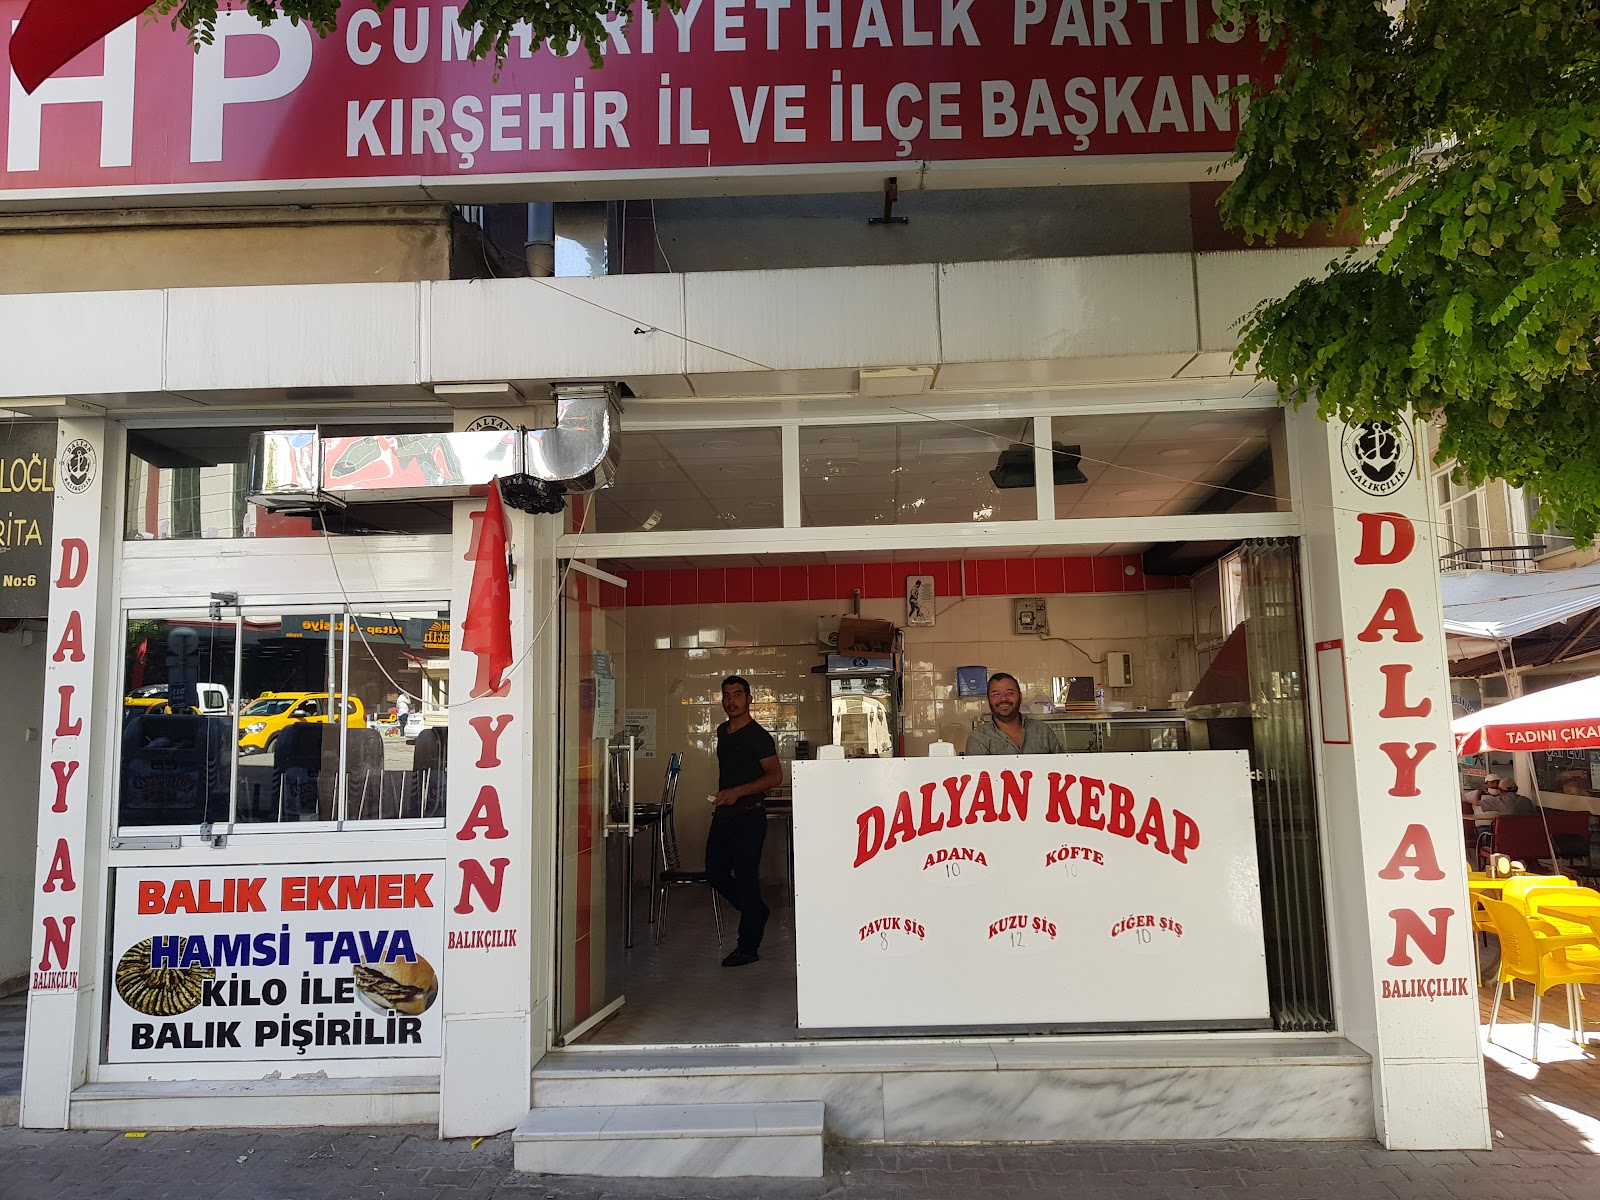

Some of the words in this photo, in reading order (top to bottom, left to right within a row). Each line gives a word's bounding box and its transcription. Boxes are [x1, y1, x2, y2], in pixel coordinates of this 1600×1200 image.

[346, 77, 631, 169] KIRŞEHİR
[659, 73, 709, 145] İL
[729, 85, 806, 143] VE
[830, 69, 963, 157] İLÇE
[0, 452, 57, 492] LOĞL
[1350, 467, 1406, 493] BALIKÇILIK
[3, 575, 37, 587] No:6
[1354, 511, 1455, 967] DALYAN
[1506, 729, 1557, 744] TADINI
[38, 538, 89, 971] DALYAN
[853, 770, 1033, 868] DALYAN
[1045, 772, 1200, 864] KEBAP
[922, 847, 988, 870] ADANA
[1045, 844, 1105, 867] KÖFTE
[945, 863, 961, 877] 10
[138, 877, 267, 915] BALIK
[280, 873, 434, 912] EKMEK
[858, 917, 901, 941] TAVUK
[903, 918, 925, 941] ŞİŞ
[988, 915, 1028, 939] KUZU
[1032, 916, 1057, 940] ŞİŞ
[1111, 913, 1155, 937] CİĞER
[1159, 915, 1183, 938] ŞİŞ
[1136, 928, 1151, 945] 10
[150, 923, 291, 968] HAMSİ
[305, 929, 418, 965] TAVA
[448, 929, 517, 953] BALIKÇILIK
[880, 932, 889, 950] 8
[1010, 931, 1025, 948] 12
[33, 971, 78, 991] BALIKÇILIK
[202, 973, 287, 1007] KİLO
[301, 971, 355, 1005] İLE
[1382, 977, 1468, 1001] BALIKÇILIK
[131, 1022, 242, 1050] BALIK
[255, 1009, 422, 1055] PİŞİRİLİR
